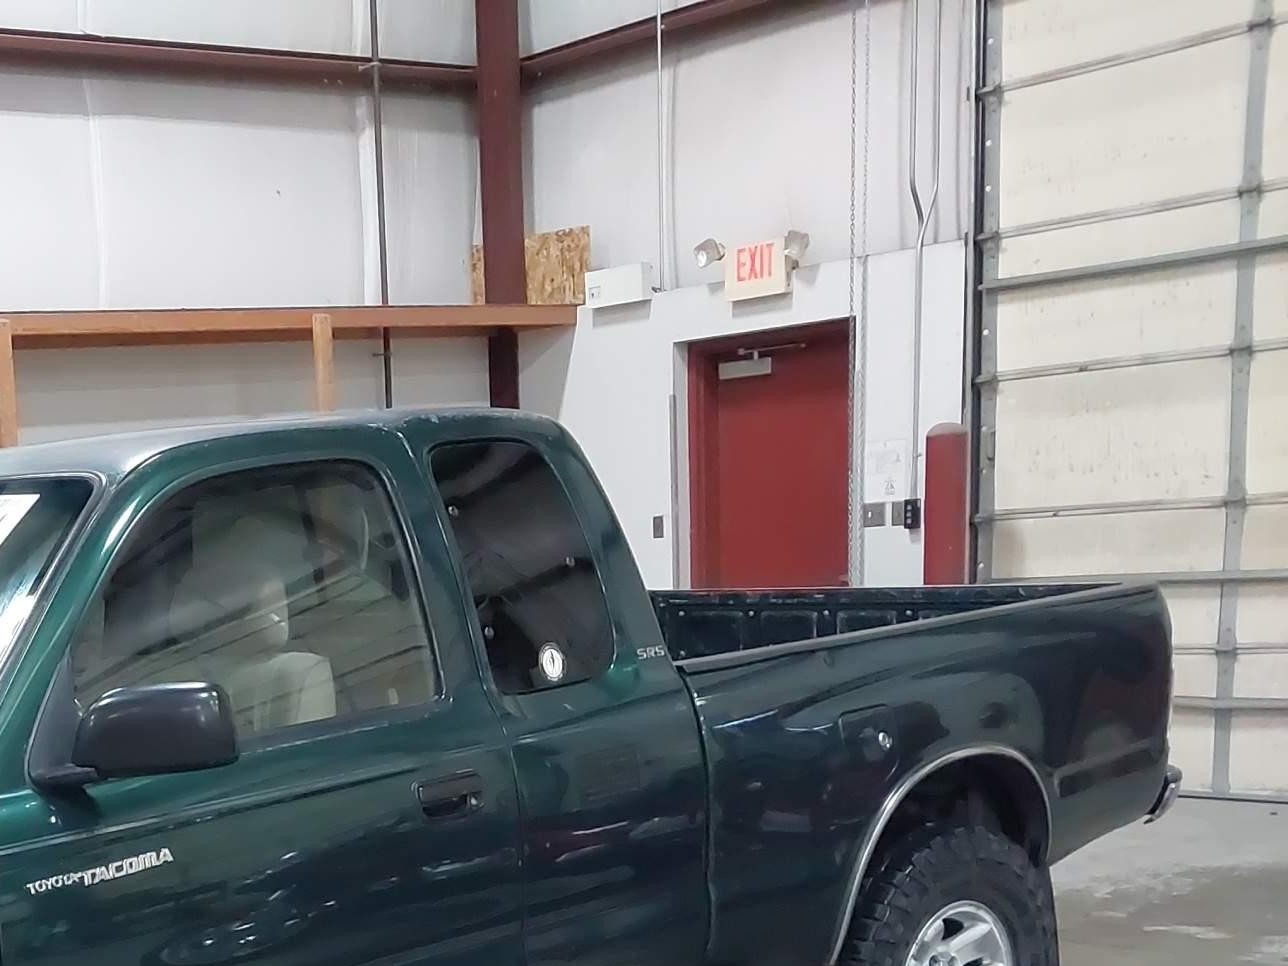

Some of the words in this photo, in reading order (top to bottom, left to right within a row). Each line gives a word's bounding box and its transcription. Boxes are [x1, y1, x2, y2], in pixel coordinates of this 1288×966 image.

[736, 242, 775, 282] EXIT
[25, 870, 81, 895] TOYOTA
[81, 847, 174, 887] TACOMA
